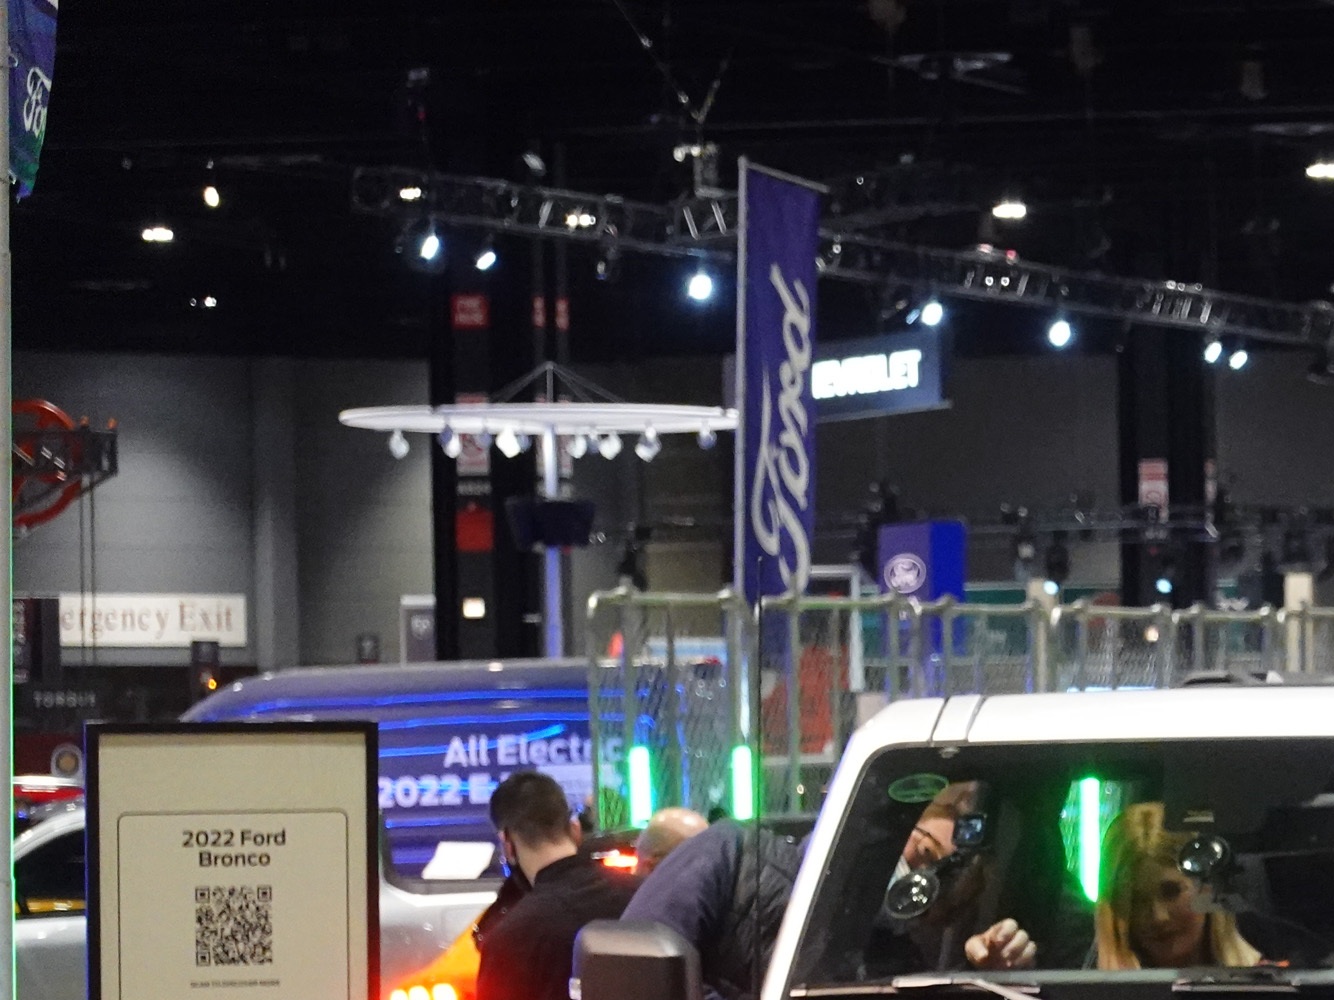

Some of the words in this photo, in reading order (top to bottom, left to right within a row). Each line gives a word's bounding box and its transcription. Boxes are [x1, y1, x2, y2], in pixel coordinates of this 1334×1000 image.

[752, 262, 812, 594] Ford
[60, 606, 170, 640] ergency
[178, 601, 233, 633] Exit
[443, 734, 490, 768] All
[378, 774, 463, 809] 2022
[182, 830, 235, 848] 2022
[240, 829, 286, 846] Ford
[199, 852, 271, 867] Bronco
